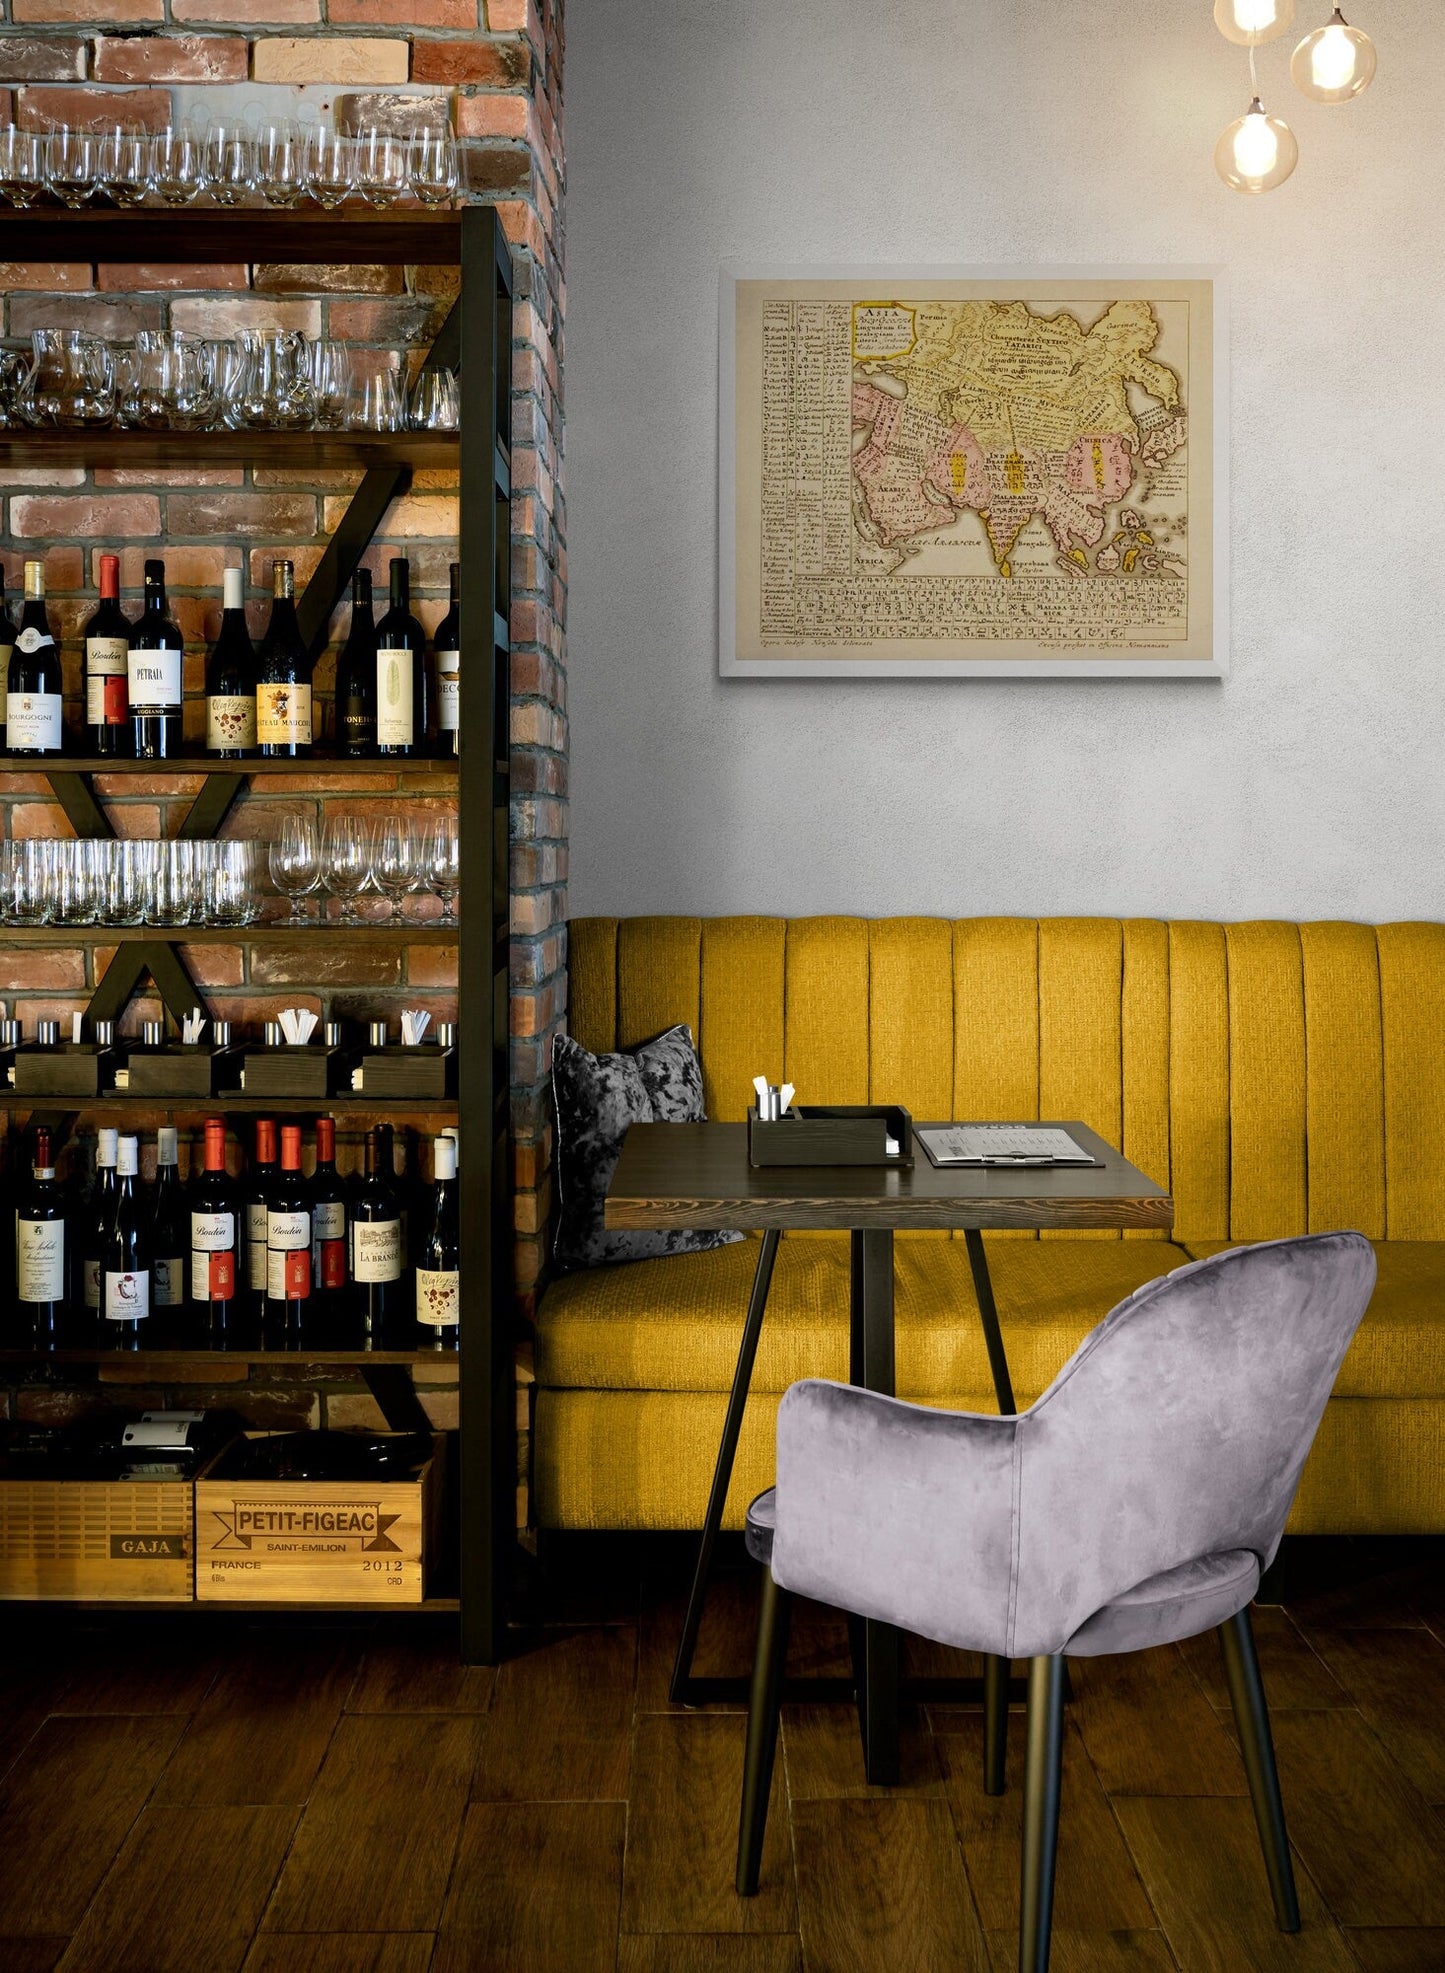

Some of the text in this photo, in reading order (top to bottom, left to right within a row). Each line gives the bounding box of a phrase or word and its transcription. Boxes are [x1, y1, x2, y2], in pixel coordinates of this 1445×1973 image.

[239, 1511, 375, 1531] PETIT-FIGEAC
[121, 1540, 171, 1555] GAJA
[267, 1543, 346, 1553] SAINT-EMILION
[211, 1560, 261, 1570] FRANCE
[362, 1560, 403, 1572] 2012
